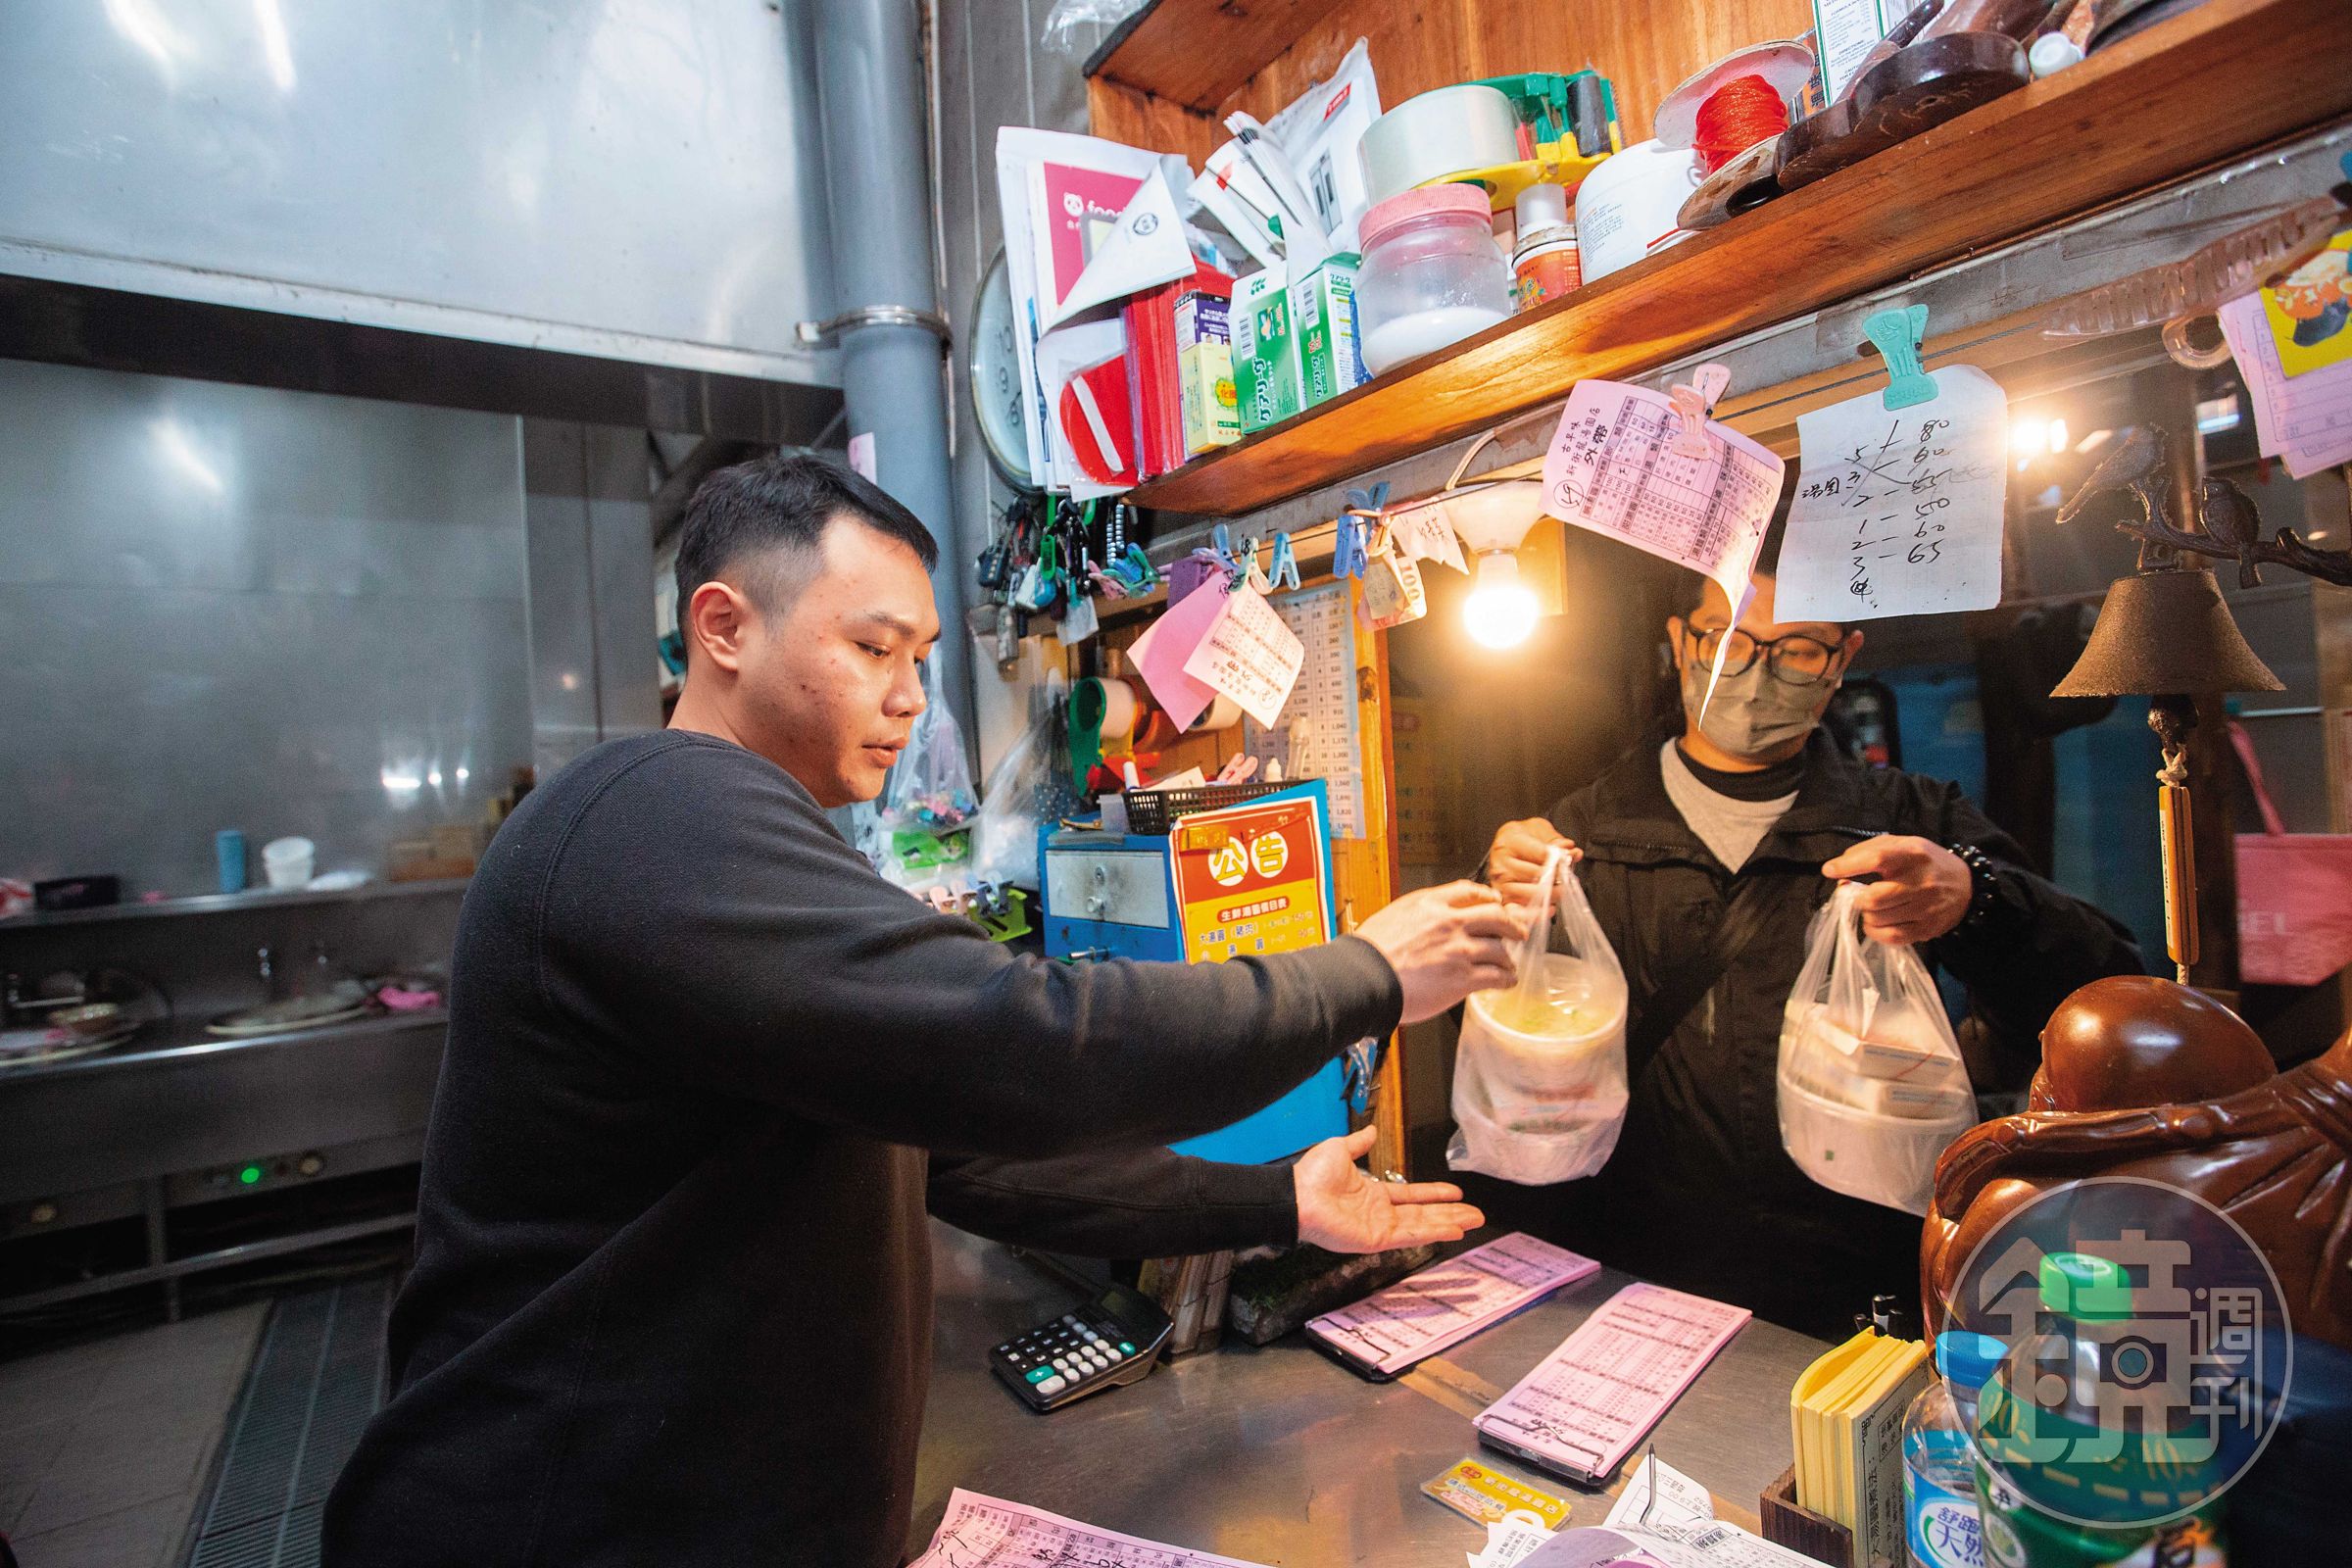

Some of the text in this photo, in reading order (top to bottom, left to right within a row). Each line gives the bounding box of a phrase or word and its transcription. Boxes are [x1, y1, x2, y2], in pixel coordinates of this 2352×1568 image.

[1582, 423, 1610, 466] 外帶
[1908, 539, 1944, 564] 65
[1213, 836, 1284, 880] 公告
[1221, 898, 1287, 921] 生鮮湯圓價目表
